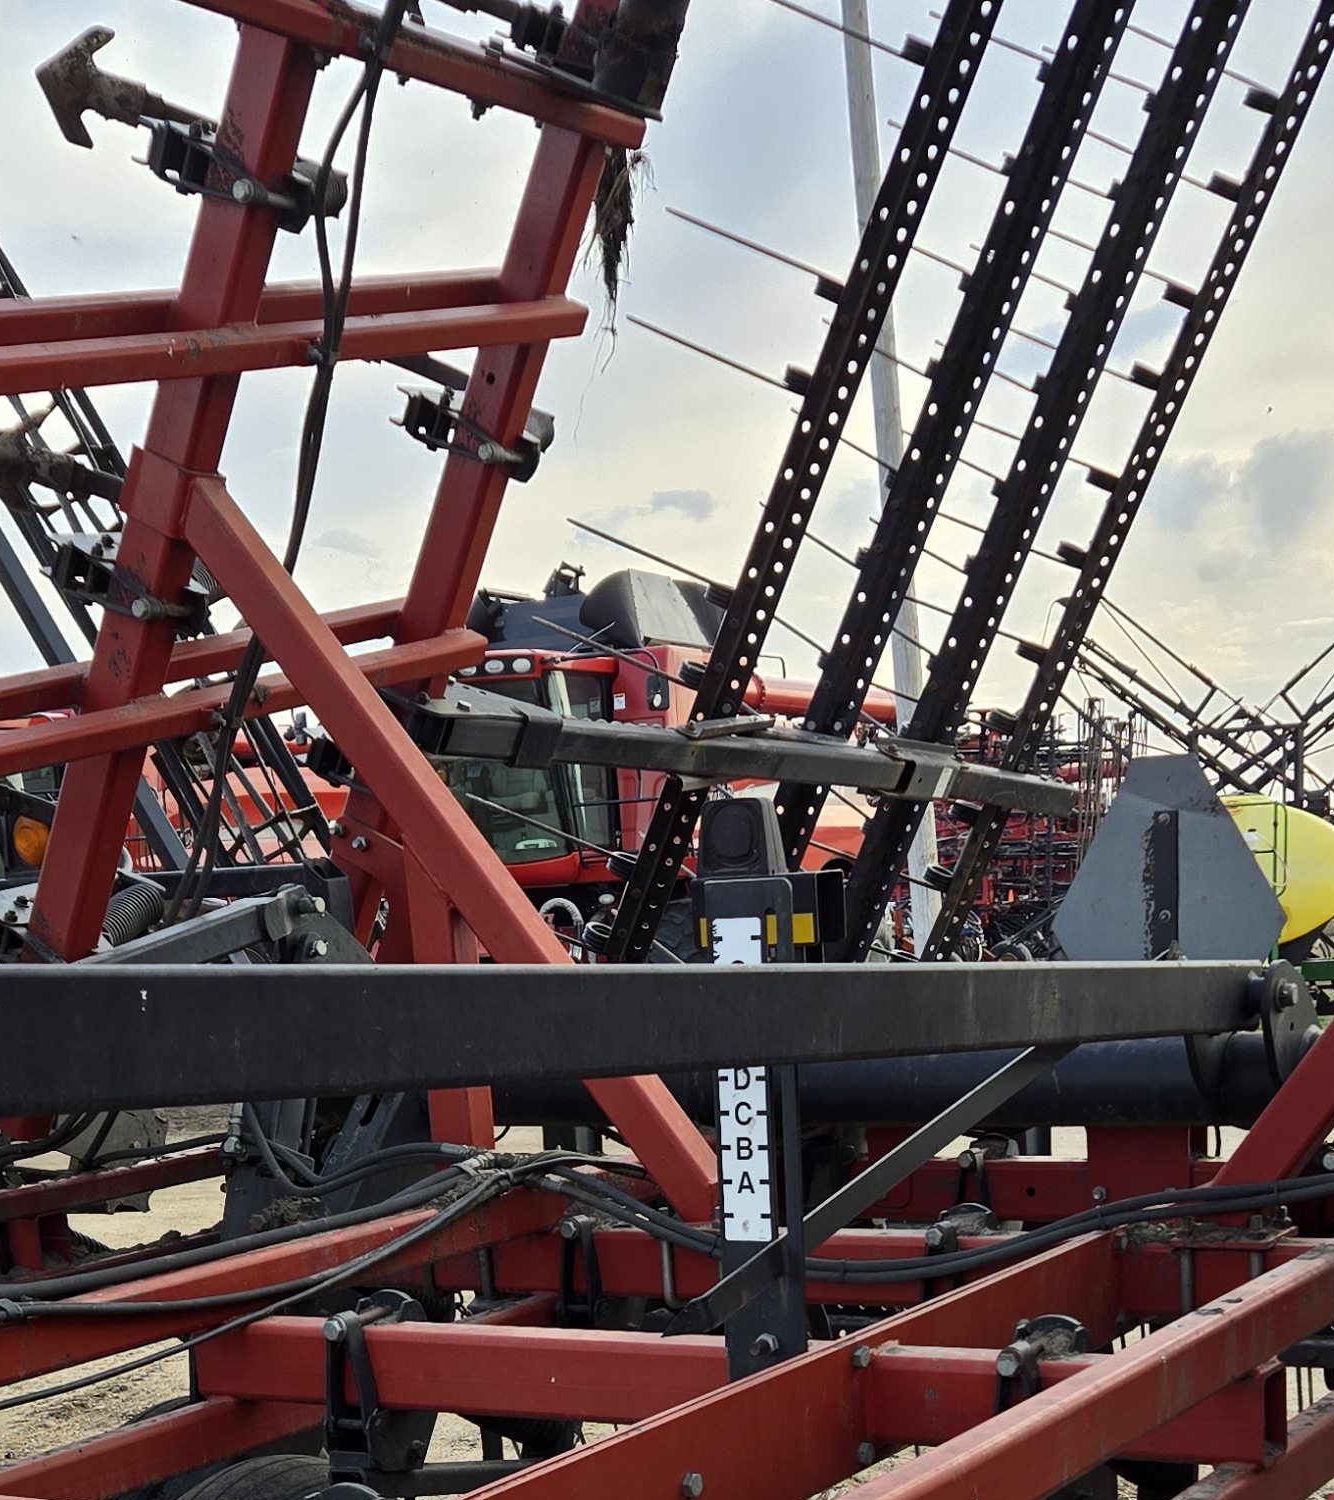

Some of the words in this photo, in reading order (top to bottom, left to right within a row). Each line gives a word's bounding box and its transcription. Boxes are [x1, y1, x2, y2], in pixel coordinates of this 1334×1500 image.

[734, 1066, 751, 1091] D
[734, 1101, 752, 1126] C
[735, 1137, 753, 1161] B
[737, 1171, 756, 1195] A
